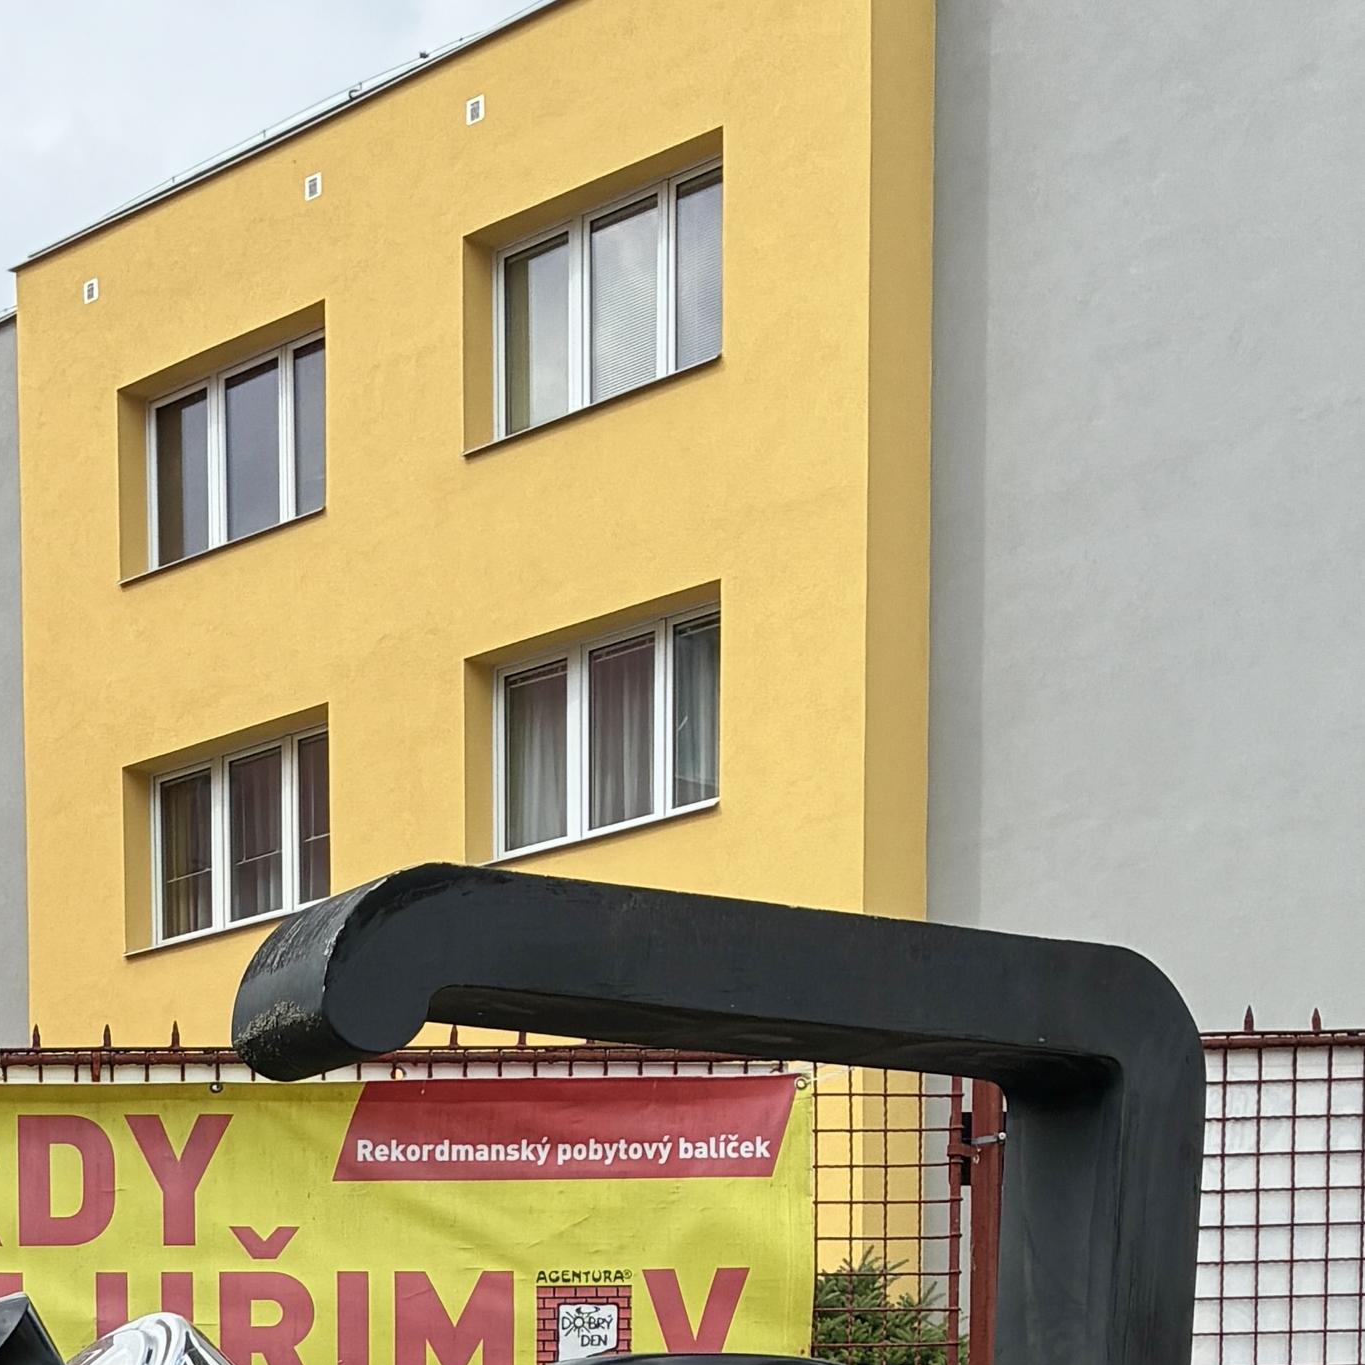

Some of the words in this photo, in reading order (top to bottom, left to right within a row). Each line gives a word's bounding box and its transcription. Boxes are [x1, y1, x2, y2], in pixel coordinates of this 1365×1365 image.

[356, 1136, 551, 1166] Rekordmanský
[557, 1135, 672, 1165] pobytový
[678, 1133, 771, 1160] balíček
[581, 1334, 608, 1347] DEN
